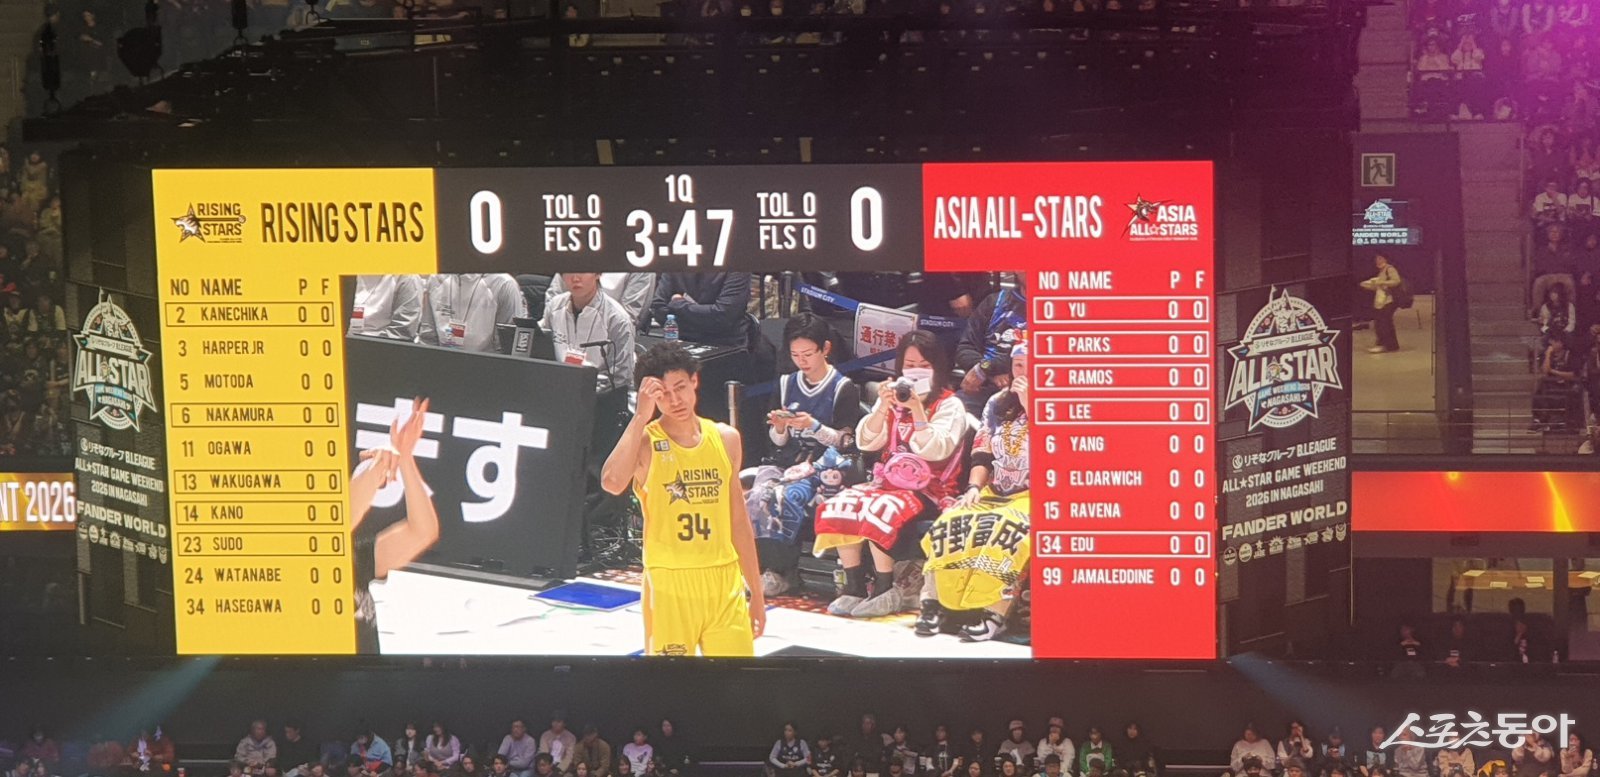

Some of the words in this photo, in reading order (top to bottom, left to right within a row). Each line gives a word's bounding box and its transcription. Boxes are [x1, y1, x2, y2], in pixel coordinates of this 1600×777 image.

[665, 174, 694, 203] 1Q
[197, 203, 241, 216] RISING
[542, 194, 579, 219] TOL
[587, 194, 600, 219] 0
[756, 192, 794, 217] TOL
[802, 192, 816, 217] 0
[1156, 205, 1196, 222] ASIA
[261, 202, 339, 243] RISING
[344, 202, 424, 243] STARS
[470, 190, 502, 254] 0
[850, 186, 883, 251] 0
[933, 196, 982, 239] ASIA
[984, 195, 1102, 239] ALL-STARS
[203, 223, 242, 236] STARS
[544, 226, 581, 251] FLS
[588, 226, 601, 251] 0
[626, 209, 734, 267] 3:47
[759, 225, 796, 250] FLS
[803, 225, 816, 250] 0
[170, 279, 189, 295] NO
[201, 279, 242, 295] NAME
[299, 278, 307, 295] P
[322, 278, 329, 295] F
[1038, 271, 1059, 290] NO
[1068, 271, 1113, 290] NAME
[1170, 270, 1181, 289] P
[1195, 270, 1205, 289] F
[176, 306, 185, 323] 2
[201, 307, 268, 321] KANECHIKA
[298, 306, 307, 322] 0
[321, 306, 330, 322] 0
[1043, 301, 1054, 319] 0
[1068, 302, 1086, 318] YU
[1168, 300, 1179, 319] 0
[1193, 300, 1203, 319] 0
[861, 326, 902, 347] 通行禁
[1046, 335, 1054, 354] 1
[1068, 336, 1111, 353] PARKS
[1168, 335, 1179, 354] 0
[1193, 335, 1204, 354] 0
[178, 340, 187, 357] 3
[202, 340, 248, 354] HARPER
[251, 340, 264, 354] JR
[300, 339, 309, 356] 0
[323, 339, 332, 356] 0
[1280, 345, 1337, 383] STAR
[108, 357, 152, 405] STAR
[180, 373, 189, 390] 5
[204, 374, 253, 388] MOTODA
[301, 373, 310, 390] 0
[324, 373, 333, 390] 0
[1044, 368, 1055, 387] 2
[1068, 369, 1114, 385] RAMOS
[1169, 368, 1179, 386] 0
[1193, 368, 1204, 386] 0
[182, 407, 190, 423] 6
[206, 407, 274, 422] NAKAMURA
[303, 407, 312, 423] 0
[326, 407, 335, 423] 0
[1045, 402, 1056, 421] 5
[1069, 404, 1092, 420] LEE
[1169, 402, 1179, 421] 0
[1193, 402, 1204, 421] 0
[182, 440, 194, 457] 11
[208, 441, 251, 455] OGAWA
[304, 440, 313, 457] 0
[327, 440, 336, 457] 0
[1045, 435, 1056, 454] 6
[1070, 436, 1105, 452] YANG
[1169, 434, 1180, 454] 0
[1194, 434, 1204, 454] 0
[1296, 437, 1337, 457] B.LEAGUE
[111, 467, 130, 484] GAME
[682, 468, 719, 481] RISING
[1046, 469, 1056, 488] 9
[1070, 470, 1084, 486] EL
[1086, 470, 1143, 486] DARWICH
[1169, 469, 1180, 488] 0
[1194, 469, 1204, 488] 0
[1274, 466, 1301, 482] GAME
[1303, 456, 1347, 476] WEEKEND
[91, 480, 108, 497] 2026
[182, 473, 197, 490] 13
[210, 474, 281, 488] WAKUGAWA
[306, 473, 315, 490] 0
[329, 473, 337, 490] 0
[688, 485, 719, 498] STARS
[1246, 490, 1270, 508] 2026
[1271, 488, 1280, 503] IN
[1280, 479, 1324, 500] NAGASAKI
[25, 481, 76, 522] 2026
[1043, 501, 1060, 520] 15
[1070, 502, 1121, 518] RAVENA
[1169, 501, 1180, 520] 0
[1194, 501, 1205, 520] 0
[76, 500, 122, 527] FANDER
[123, 513, 167, 539] WORLD
[183, 505, 199, 522] 14
[211, 505, 243, 519] KANO
[308, 505, 316, 522] 0
[330, 505, 339, 522] 0
[1222, 513, 1287, 541] FANDER
[1290, 501, 1348, 525] WORLD
[677, 513, 711, 541] 34
[183, 536, 202, 553] 23
[213, 536, 243, 551] SUDO
[309, 536, 317, 553] 0
[332, 536, 340, 553] 0
[1042, 535, 1062, 554] 34
[1070, 536, 1094, 552] EDU
[1170, 535, 1180, 554] 0
[1194, 535, 1205, 554] 0
[184, 567, 203, 584] 24
[214, 567, 282, 582] WATANABE
[310, 567, 319, 584] 0
[333, 567, 341, 584] 0
[1043, 567, 1062, 586] 99
[1071, 568, 1155, 584] JAMALEDDINE
[1170, 567, 1181, 586] 0
[1195, 567, 1205, 586] 0
[187, 598, 205, 615] 34
[215, 599, 282, 613] HASEGAWA
[312, 598, 320, 615] 0
[334, 598, 343, 615] 0
